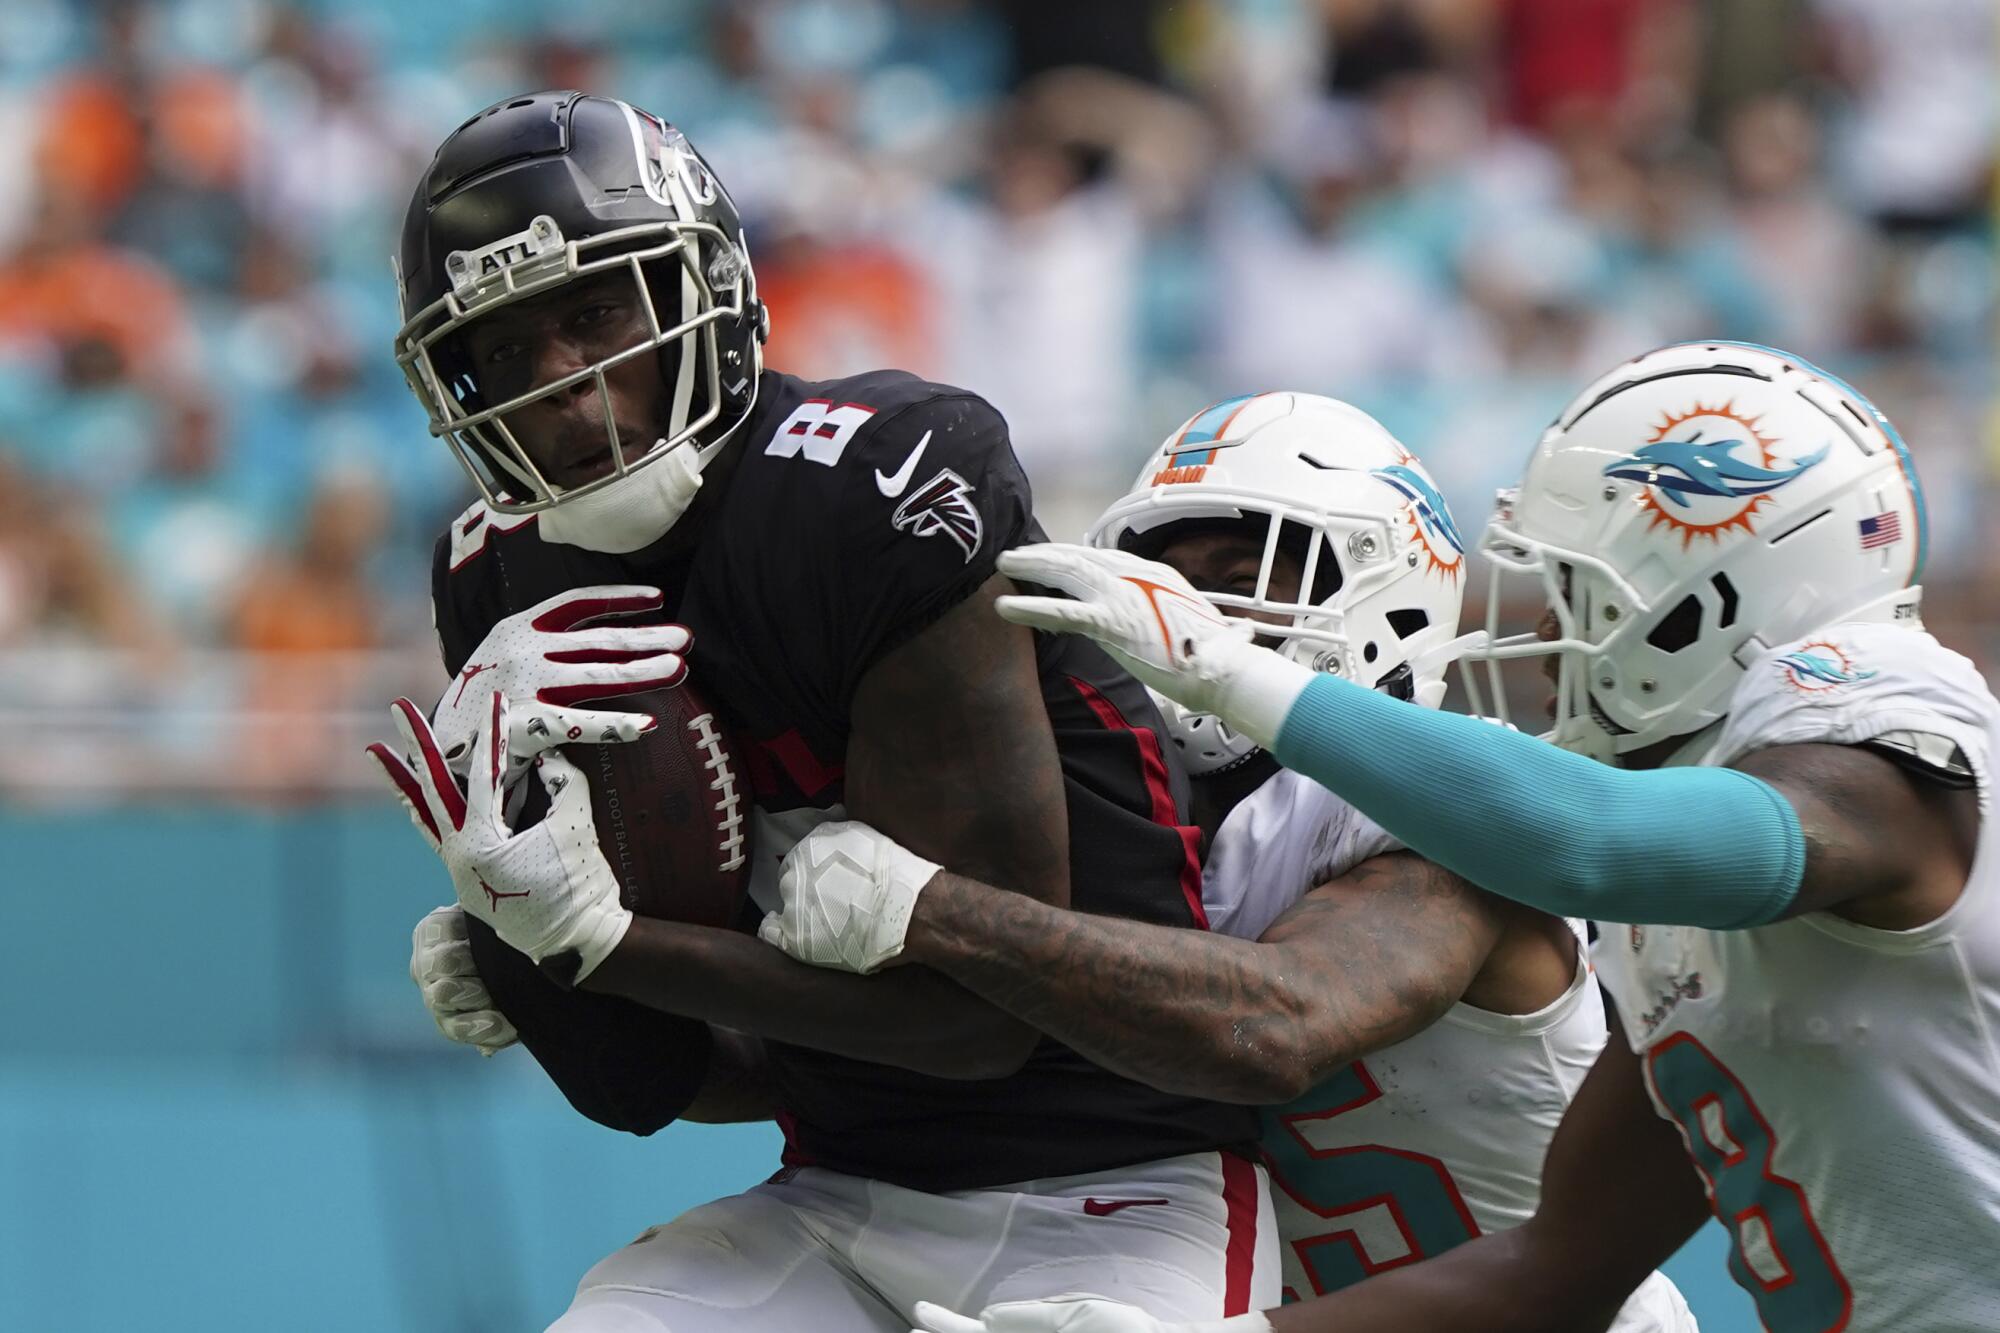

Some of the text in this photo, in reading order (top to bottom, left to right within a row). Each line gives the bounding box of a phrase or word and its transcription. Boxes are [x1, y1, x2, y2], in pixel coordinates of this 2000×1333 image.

[480, 242, 547, 275] ATL
[764, 398, 879, 468] 8
[567, 726, 582, 741] 8
[606, 788, 633, 870] FOOTBALL
[1647, 1031, 1854, 1333] 8
